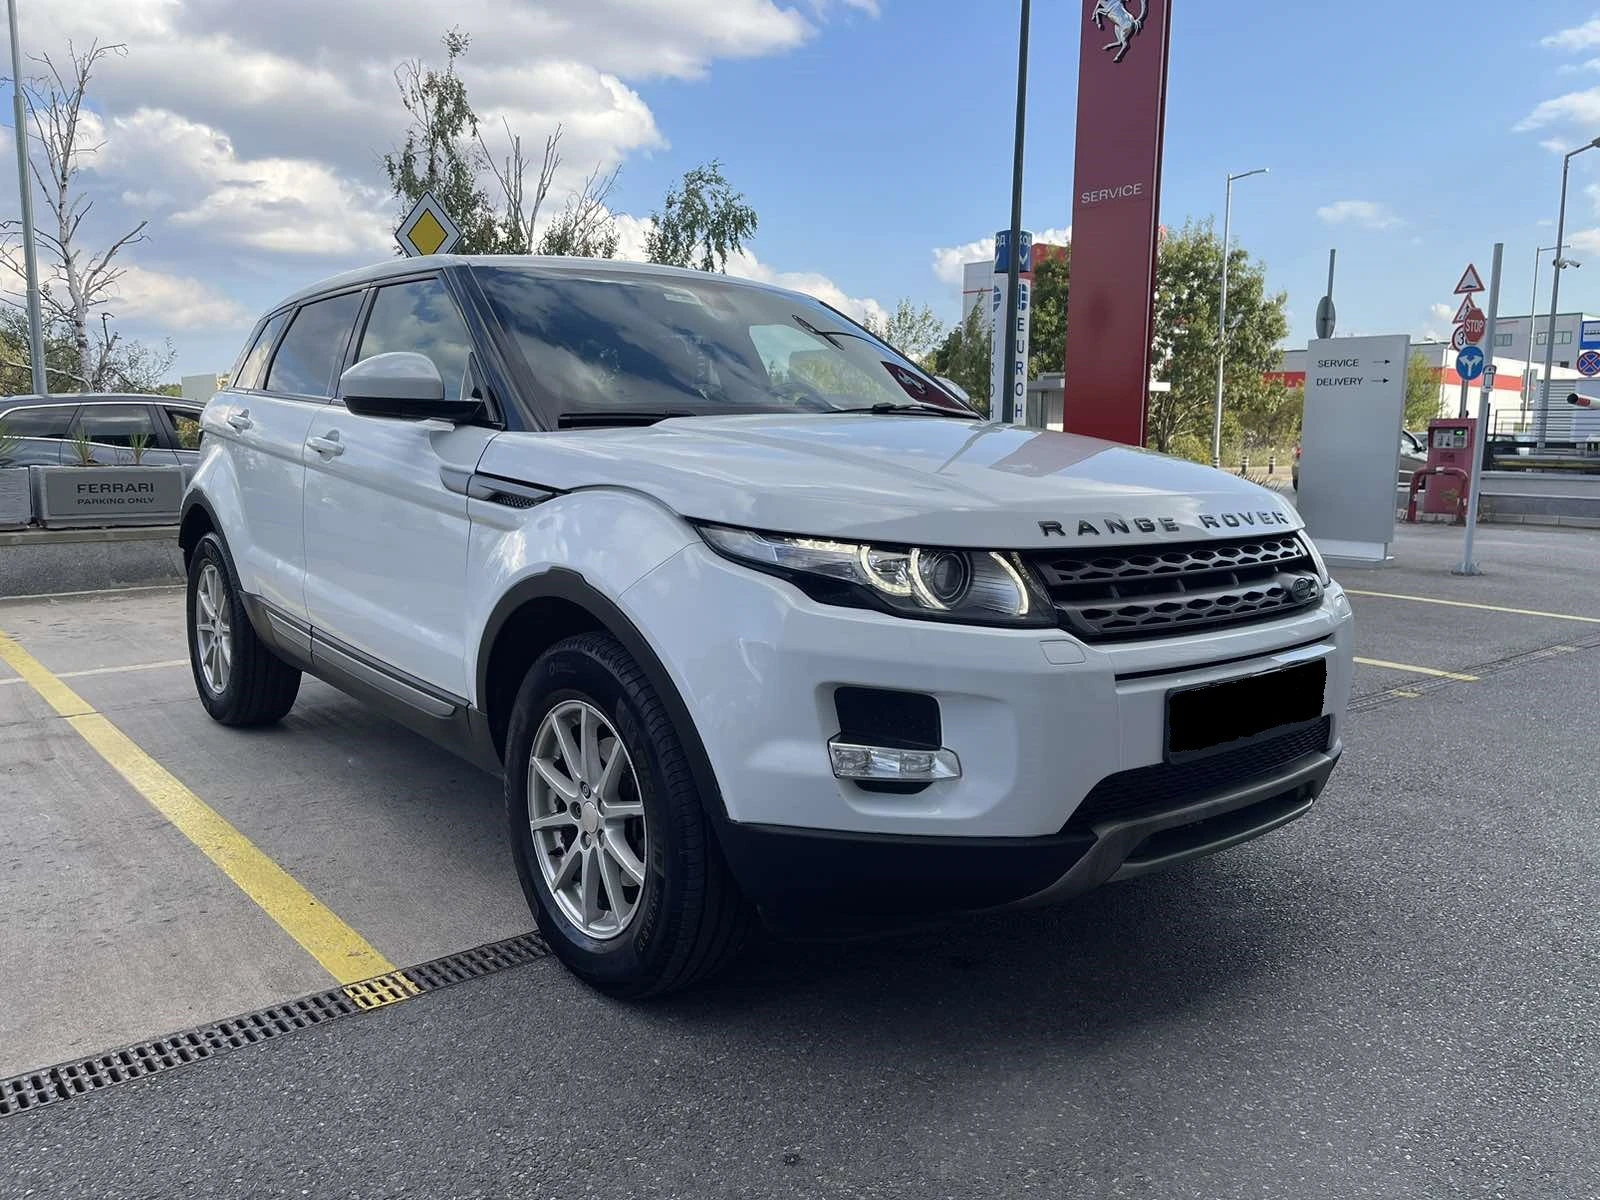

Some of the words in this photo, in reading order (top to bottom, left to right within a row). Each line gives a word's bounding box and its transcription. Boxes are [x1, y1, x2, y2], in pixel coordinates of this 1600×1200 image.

[1081, 183, 1143, 204] SERVICE
[1465, 320, 1484, 333] STOP
[1317, 358, 1360, 368] SERVICE
[1316, 377, 1364, 386] DELIVERY
[77, 483, 154, 493] FERRARI
[1037, 517, 1180, 537] RANGE
[1198, 511, 1289, 529] ROVER
